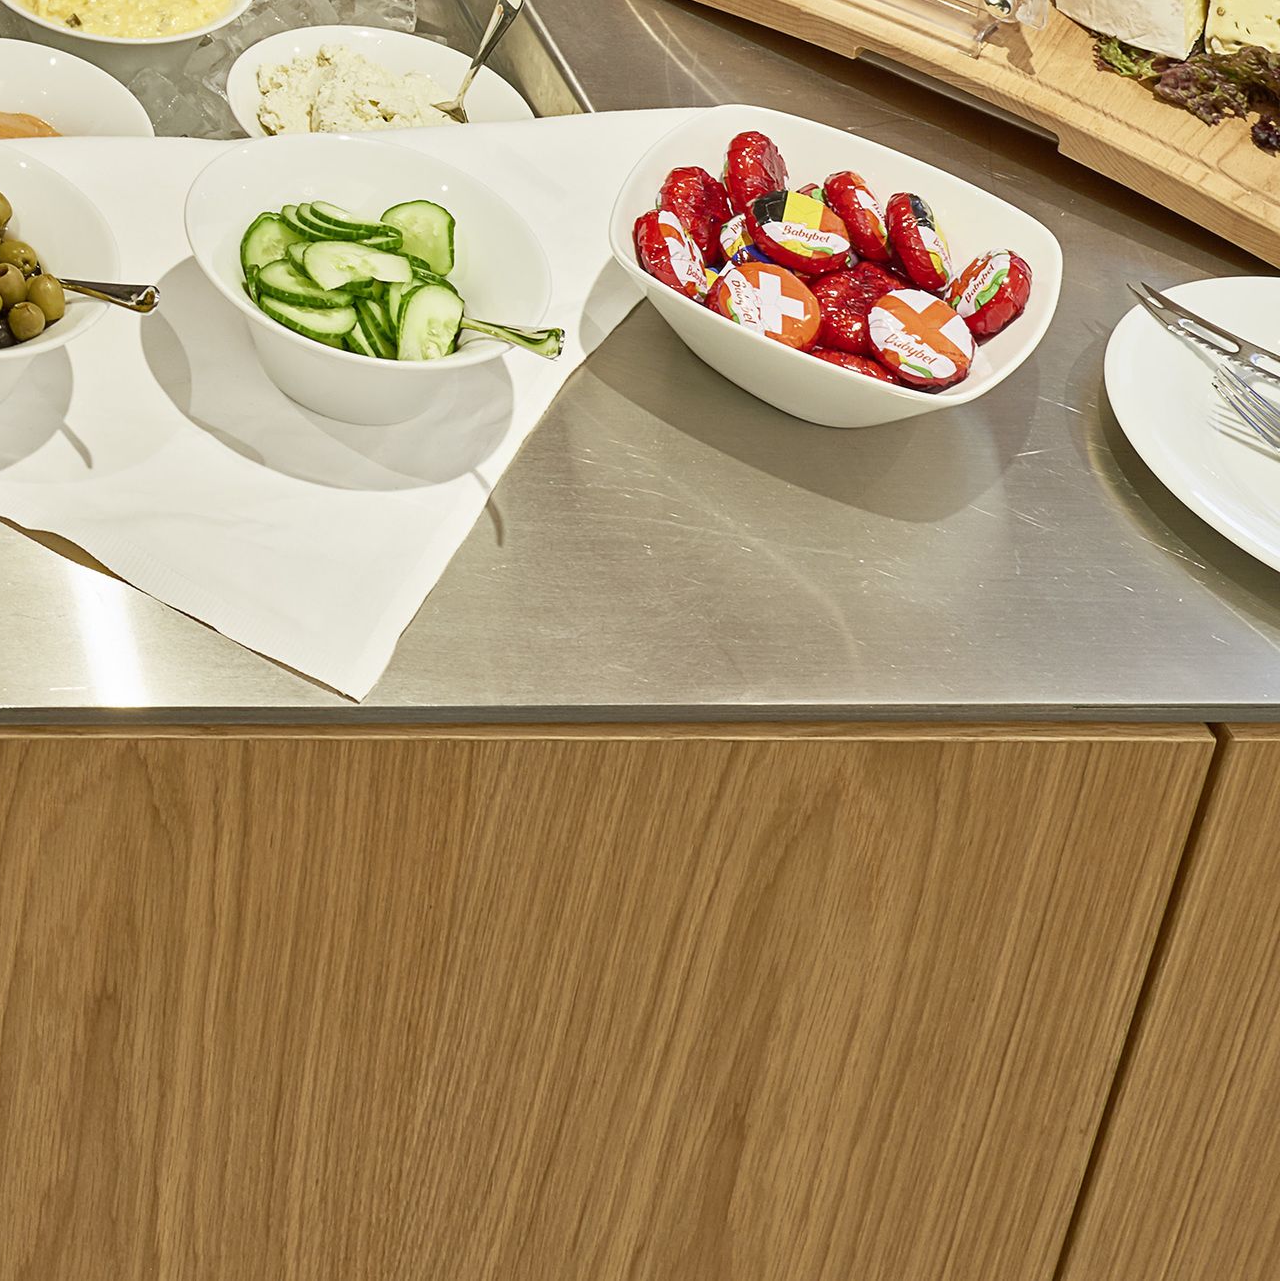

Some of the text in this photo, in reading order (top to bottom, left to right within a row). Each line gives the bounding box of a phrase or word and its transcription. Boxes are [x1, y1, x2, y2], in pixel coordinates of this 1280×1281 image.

[782, 223, 831, 244] Babybel
[964, 263, 996, 305] Babybel
[884, 332, 939, 366] Babybel
